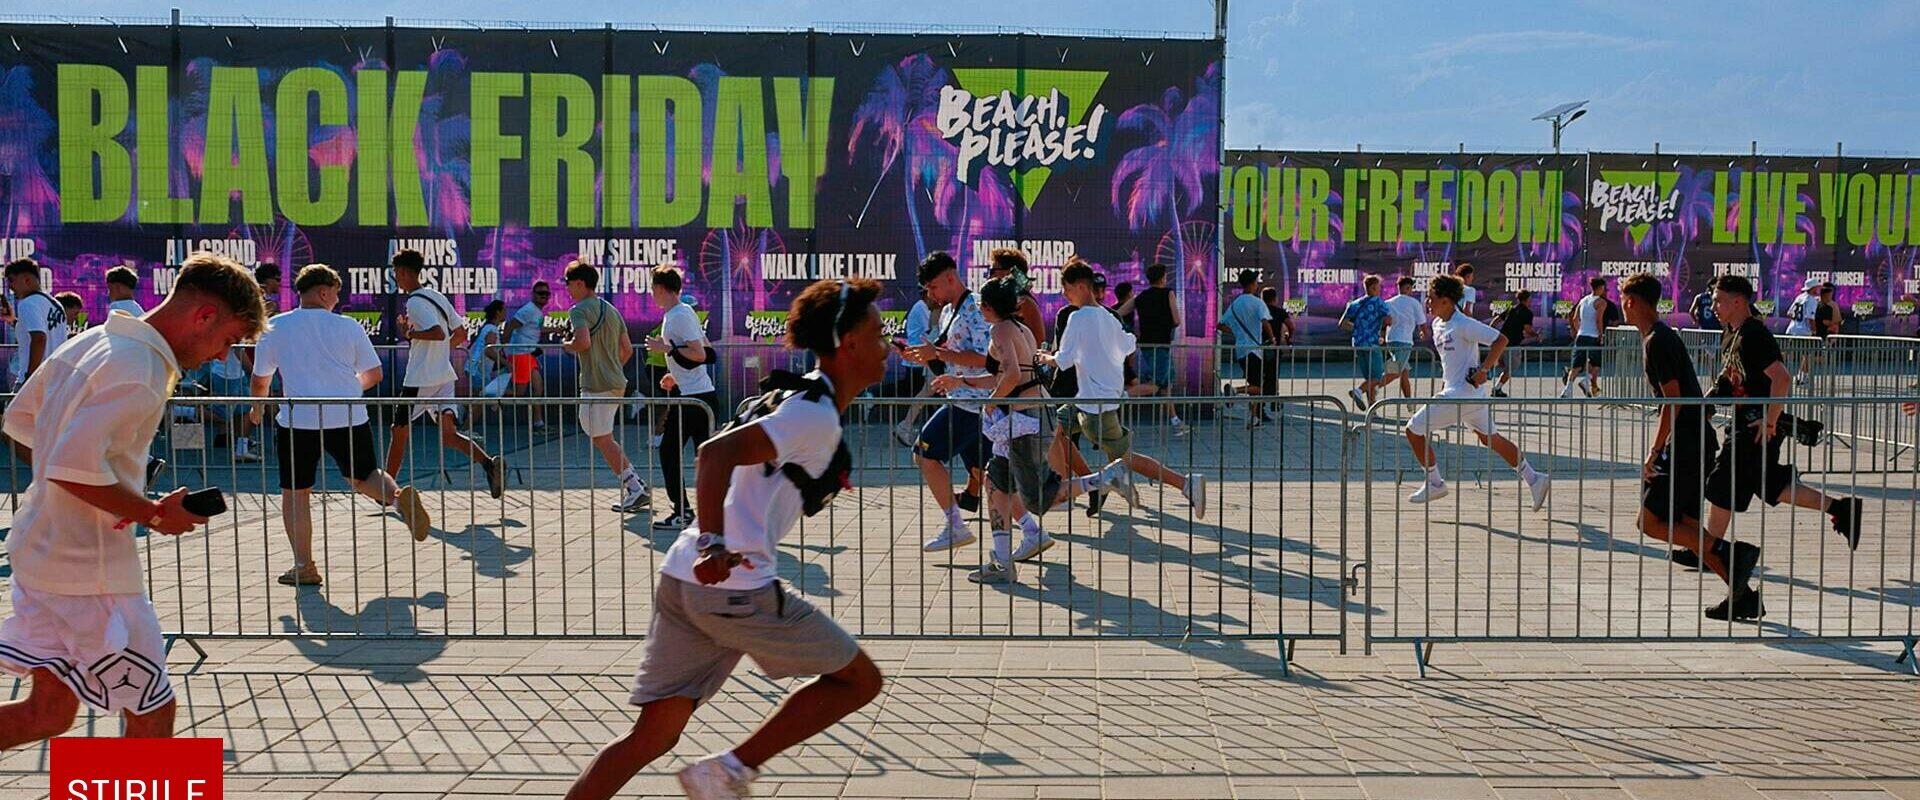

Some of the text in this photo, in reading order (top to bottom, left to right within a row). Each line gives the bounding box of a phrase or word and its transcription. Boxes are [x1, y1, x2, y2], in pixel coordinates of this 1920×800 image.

[56, 64, 835, 229] BLACK FRIDAY
[957, 103, 1105, 184] PLEASE!
[1343, 168, 1564, 243] FREEDOM
[1600, 189, 1679, 232] PLEASE!
[1711, 171, 1809, 245] LIVE
[578, 238, 677, 265] MY SILENCE
[1021, 240, 1075, 266] SHARP
[761, 253, 807, 279] WALK
[811, 254, 844, 280] LIKE
[856, 254, 896, 280] TALK
[1297, 269, 1315, 283] I'VE
[1316, 269, 1339, 283] BEEN
[1414, 262, 1450, 276] MAKE IT
[1505, 262, 1562, 277] CLEAN SLATE
[1600, 261, 1639, 276] RESPECT
[1713, 263, 1760, 277] THE VISION
[1832, 272, 1864, 286] CHOSEN
[348, 267, 498, 294] TEN SPS AHEAD
[1505, 278, 1562, 292] FULL HUNGER
